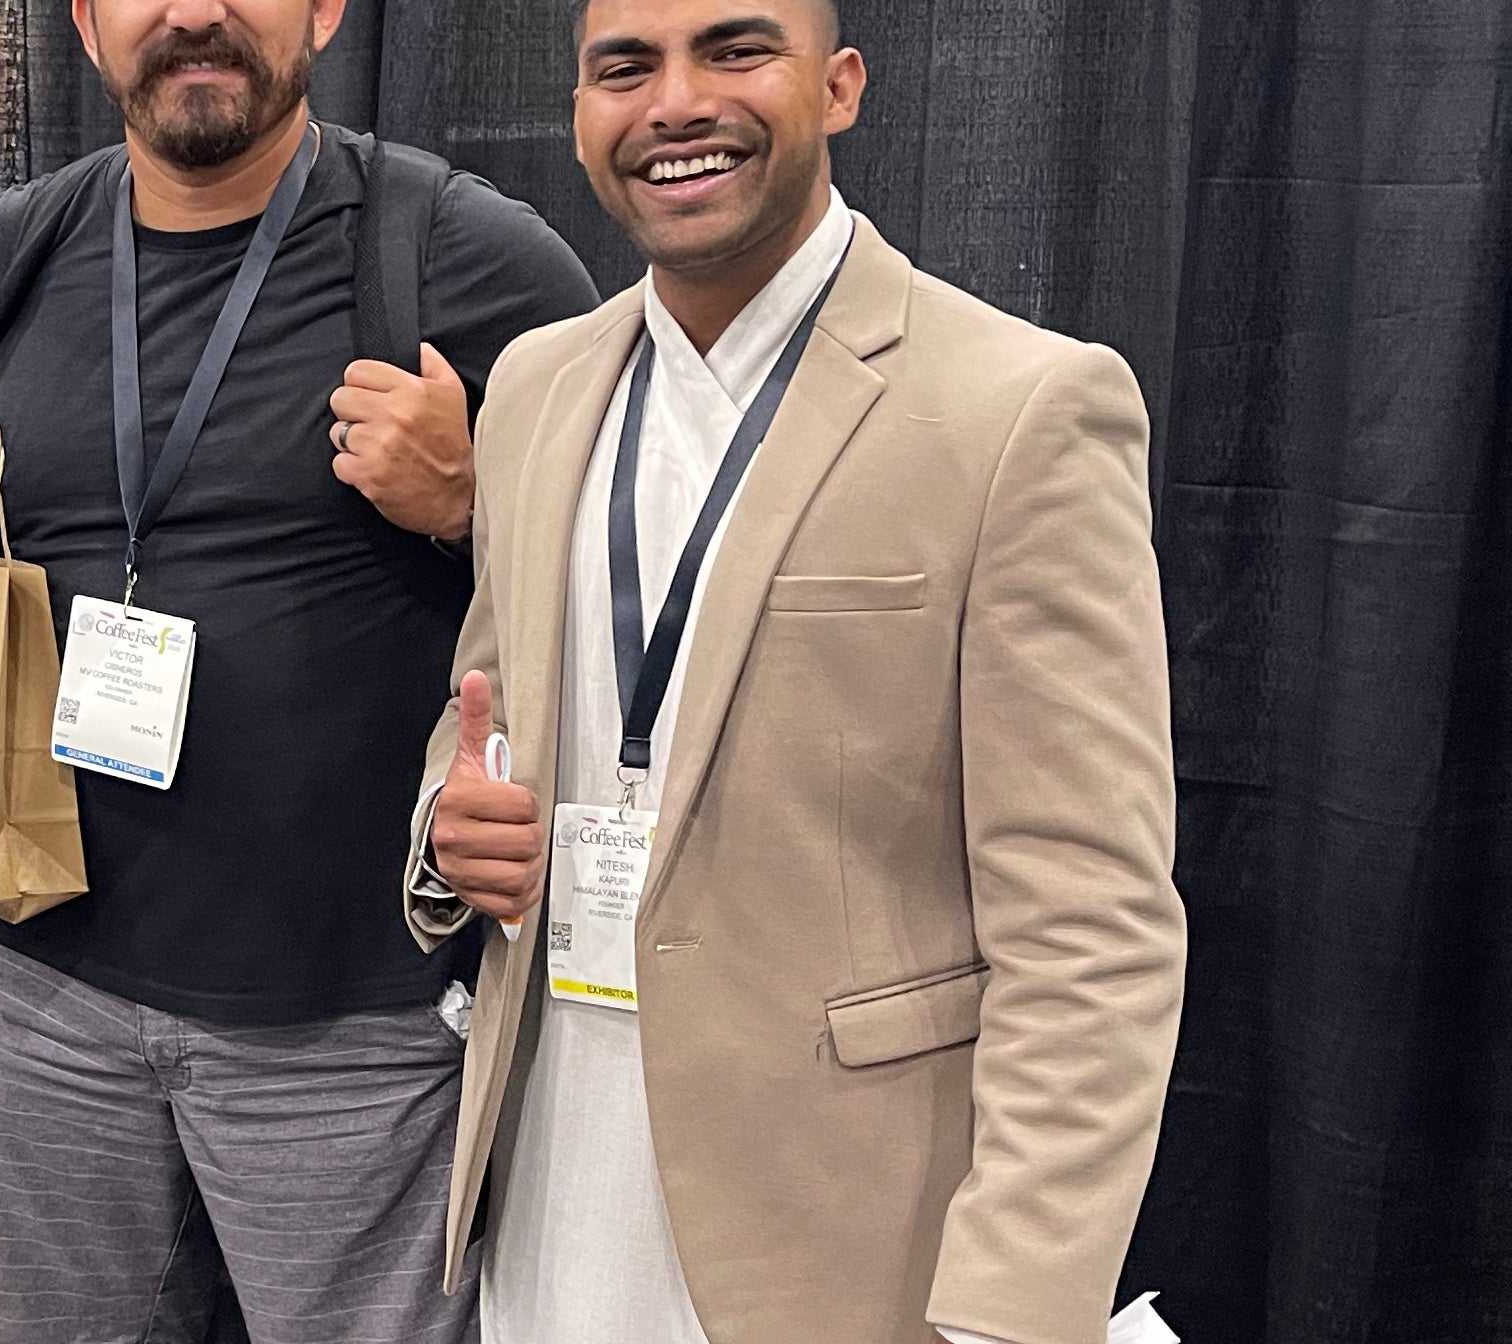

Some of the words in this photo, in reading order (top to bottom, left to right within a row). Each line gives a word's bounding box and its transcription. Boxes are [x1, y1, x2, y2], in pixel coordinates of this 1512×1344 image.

[108, 647, 144, 666] VICTOR
[92, 670, 122, 684] COFFEE
[122, 677, 163, 695] ROASTERS
[66, 747, 106, 767] GENERAL
[107, 760, 152, 779] ATTENDEE
[596, 859, 635, 874] NITESH
[573, 885, 619, 898] HIMALAYAN
[586, 984, 635, 1001] EXHIBITOR
